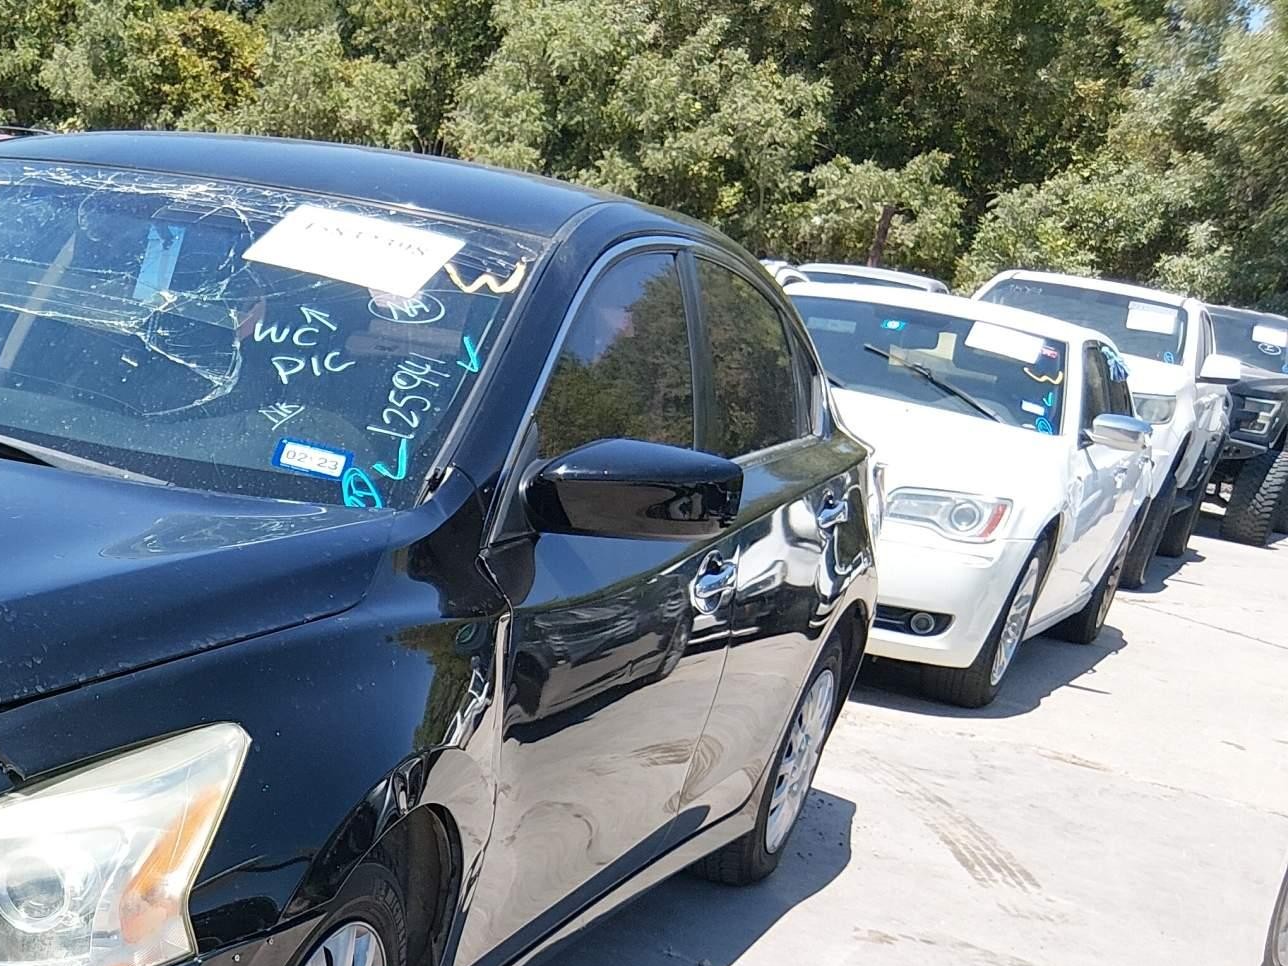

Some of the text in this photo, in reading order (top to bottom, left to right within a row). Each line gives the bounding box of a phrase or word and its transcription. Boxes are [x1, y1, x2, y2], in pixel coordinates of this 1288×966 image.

[253, 321, 320, 347] WC
[366, 352, 451, 439] 125941
[286, 449, 339, 471] 02 23
